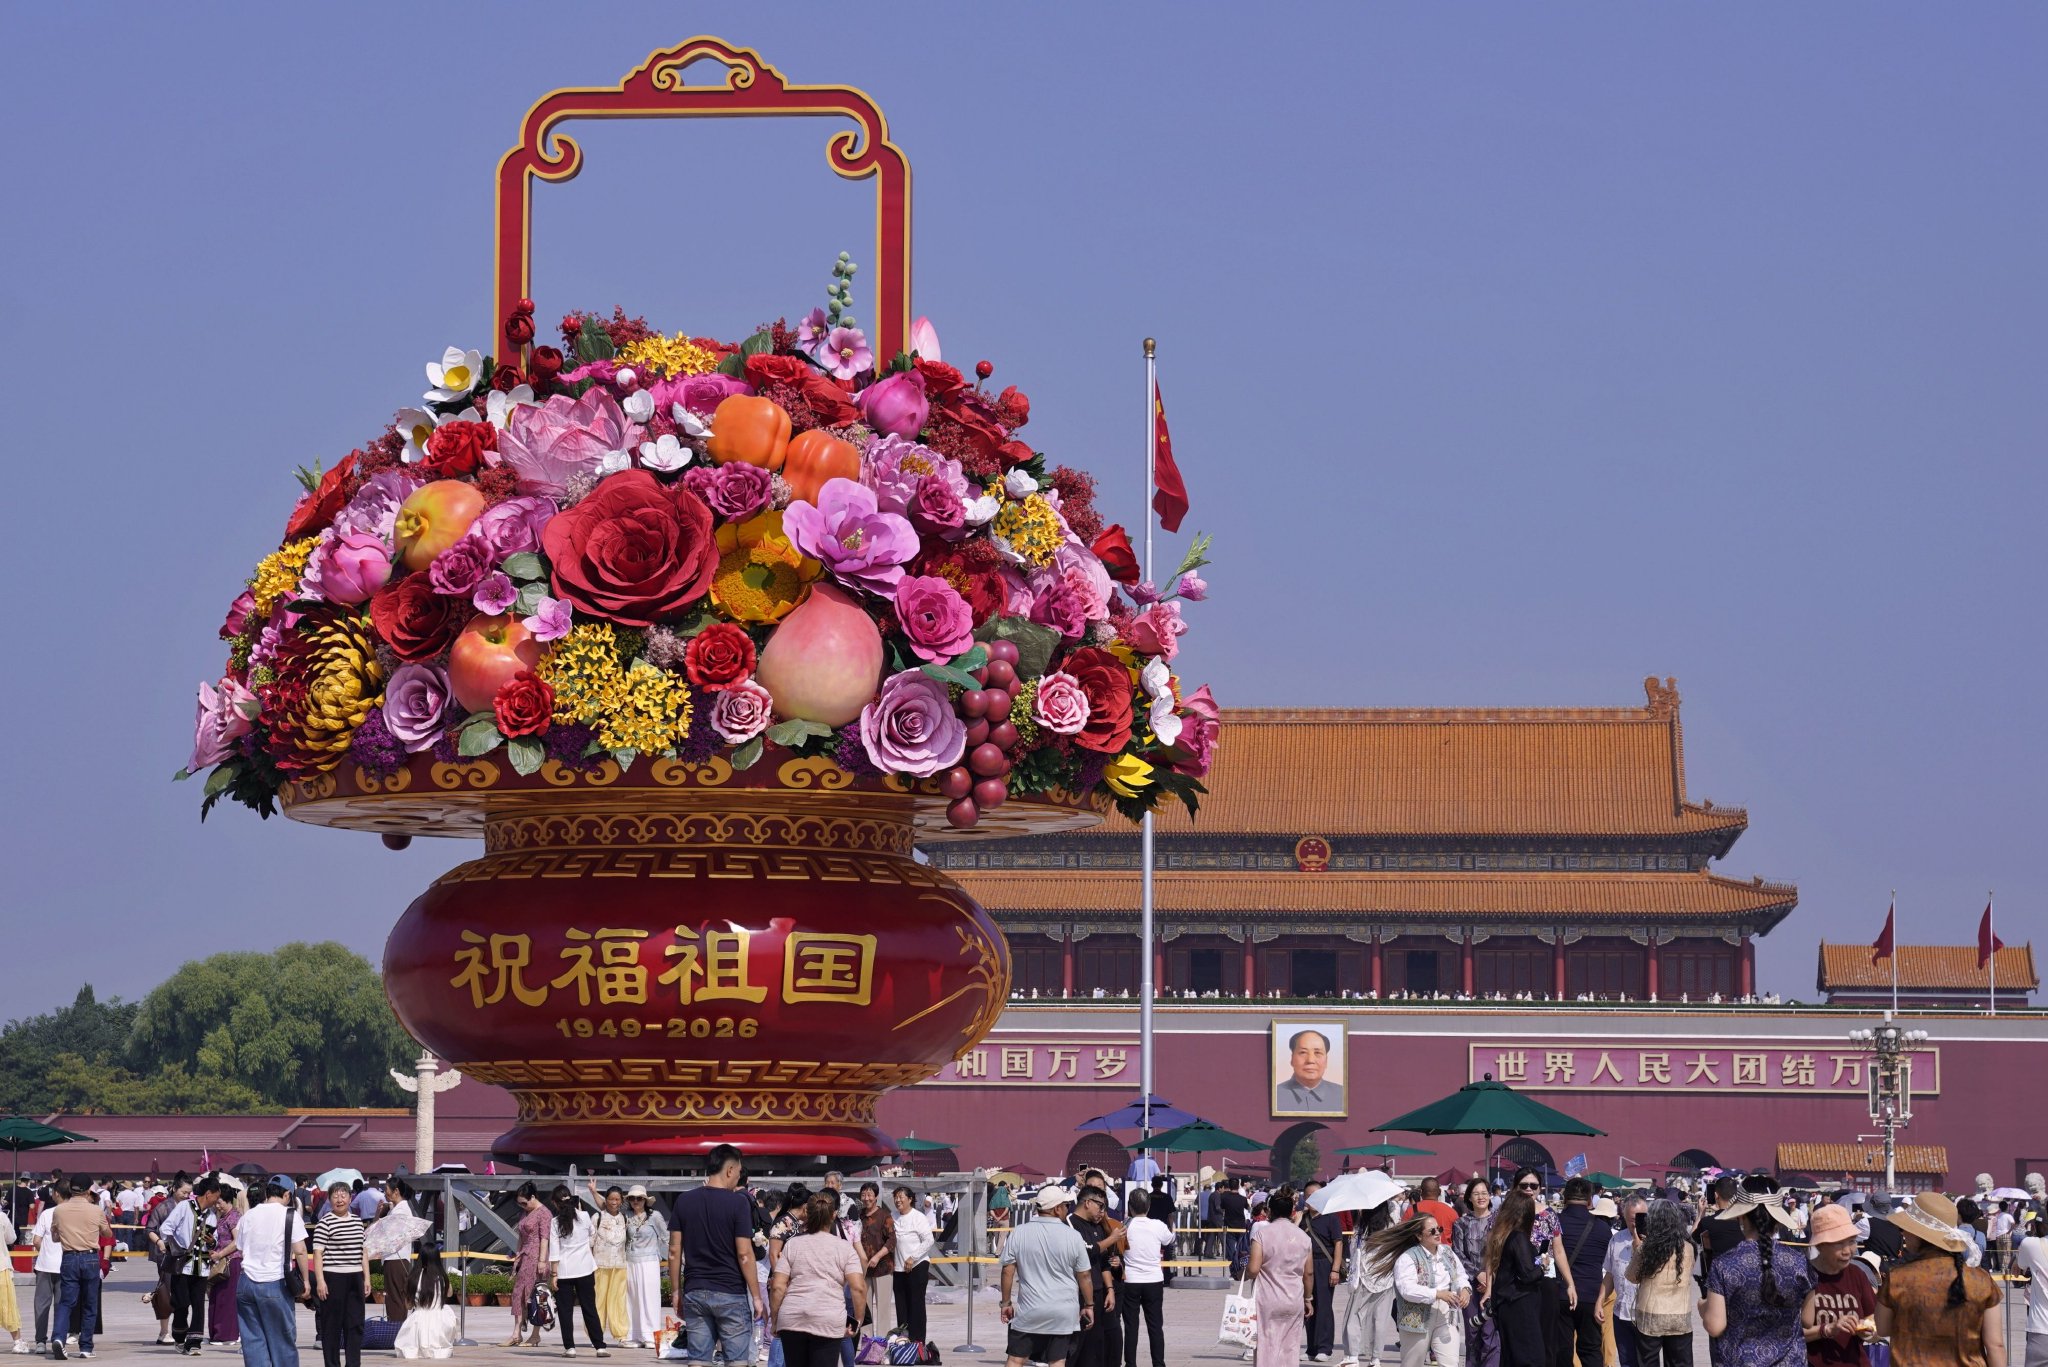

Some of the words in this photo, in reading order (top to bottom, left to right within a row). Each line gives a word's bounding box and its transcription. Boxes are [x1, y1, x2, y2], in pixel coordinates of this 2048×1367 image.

[450, 925, 878, 1009] 祝福祖国
[555, 1016, 759, 1039] 1949-2026
[933, 1047, 1128, 1080] 和国万岁
